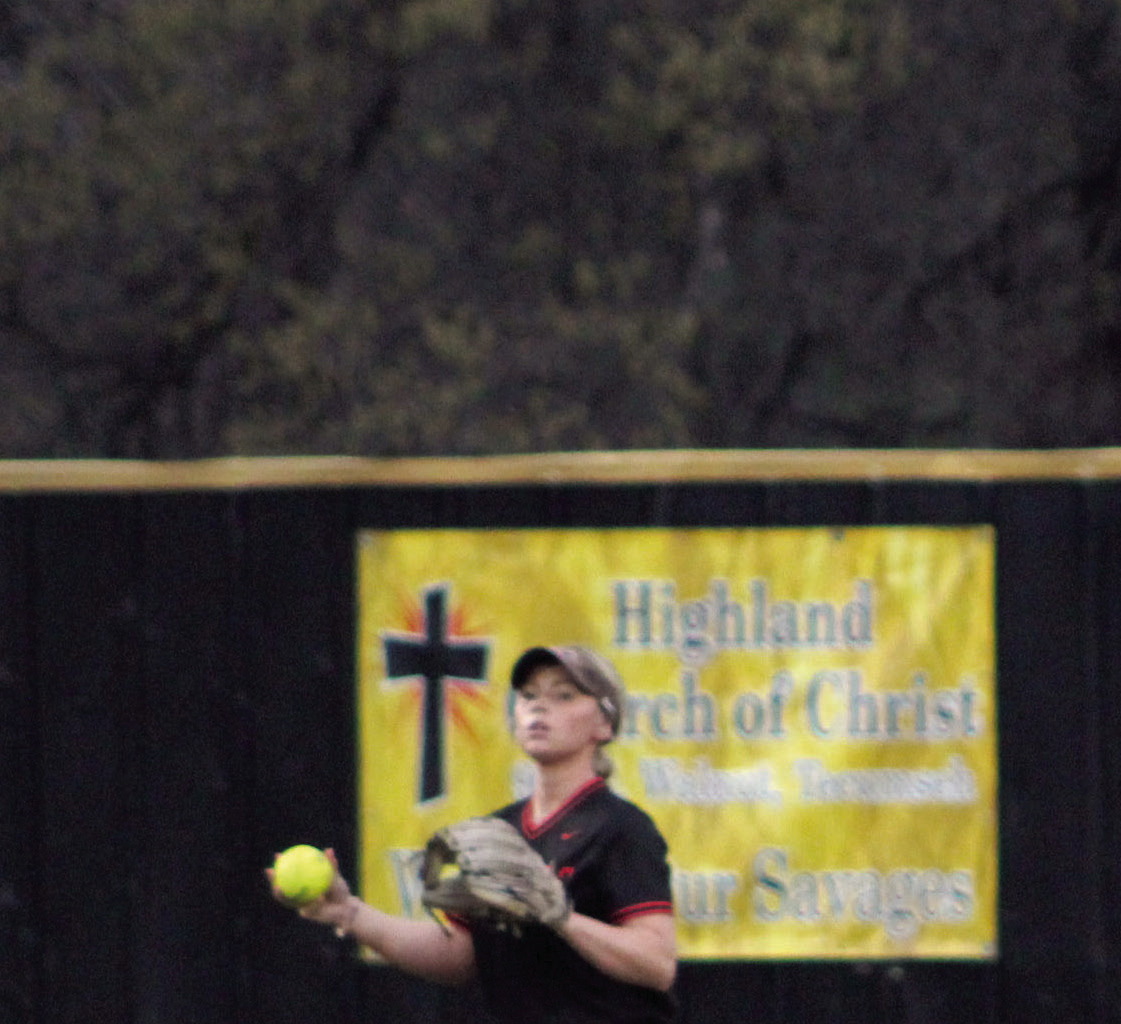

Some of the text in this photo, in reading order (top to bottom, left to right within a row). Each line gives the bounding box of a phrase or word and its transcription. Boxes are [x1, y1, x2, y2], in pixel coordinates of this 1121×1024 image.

[611, 578, 875, 664] Highland
[733, 669, 794, 740] of
[806, 669, 982, 740] Christ
[754, 847, 974, 937] Savages
